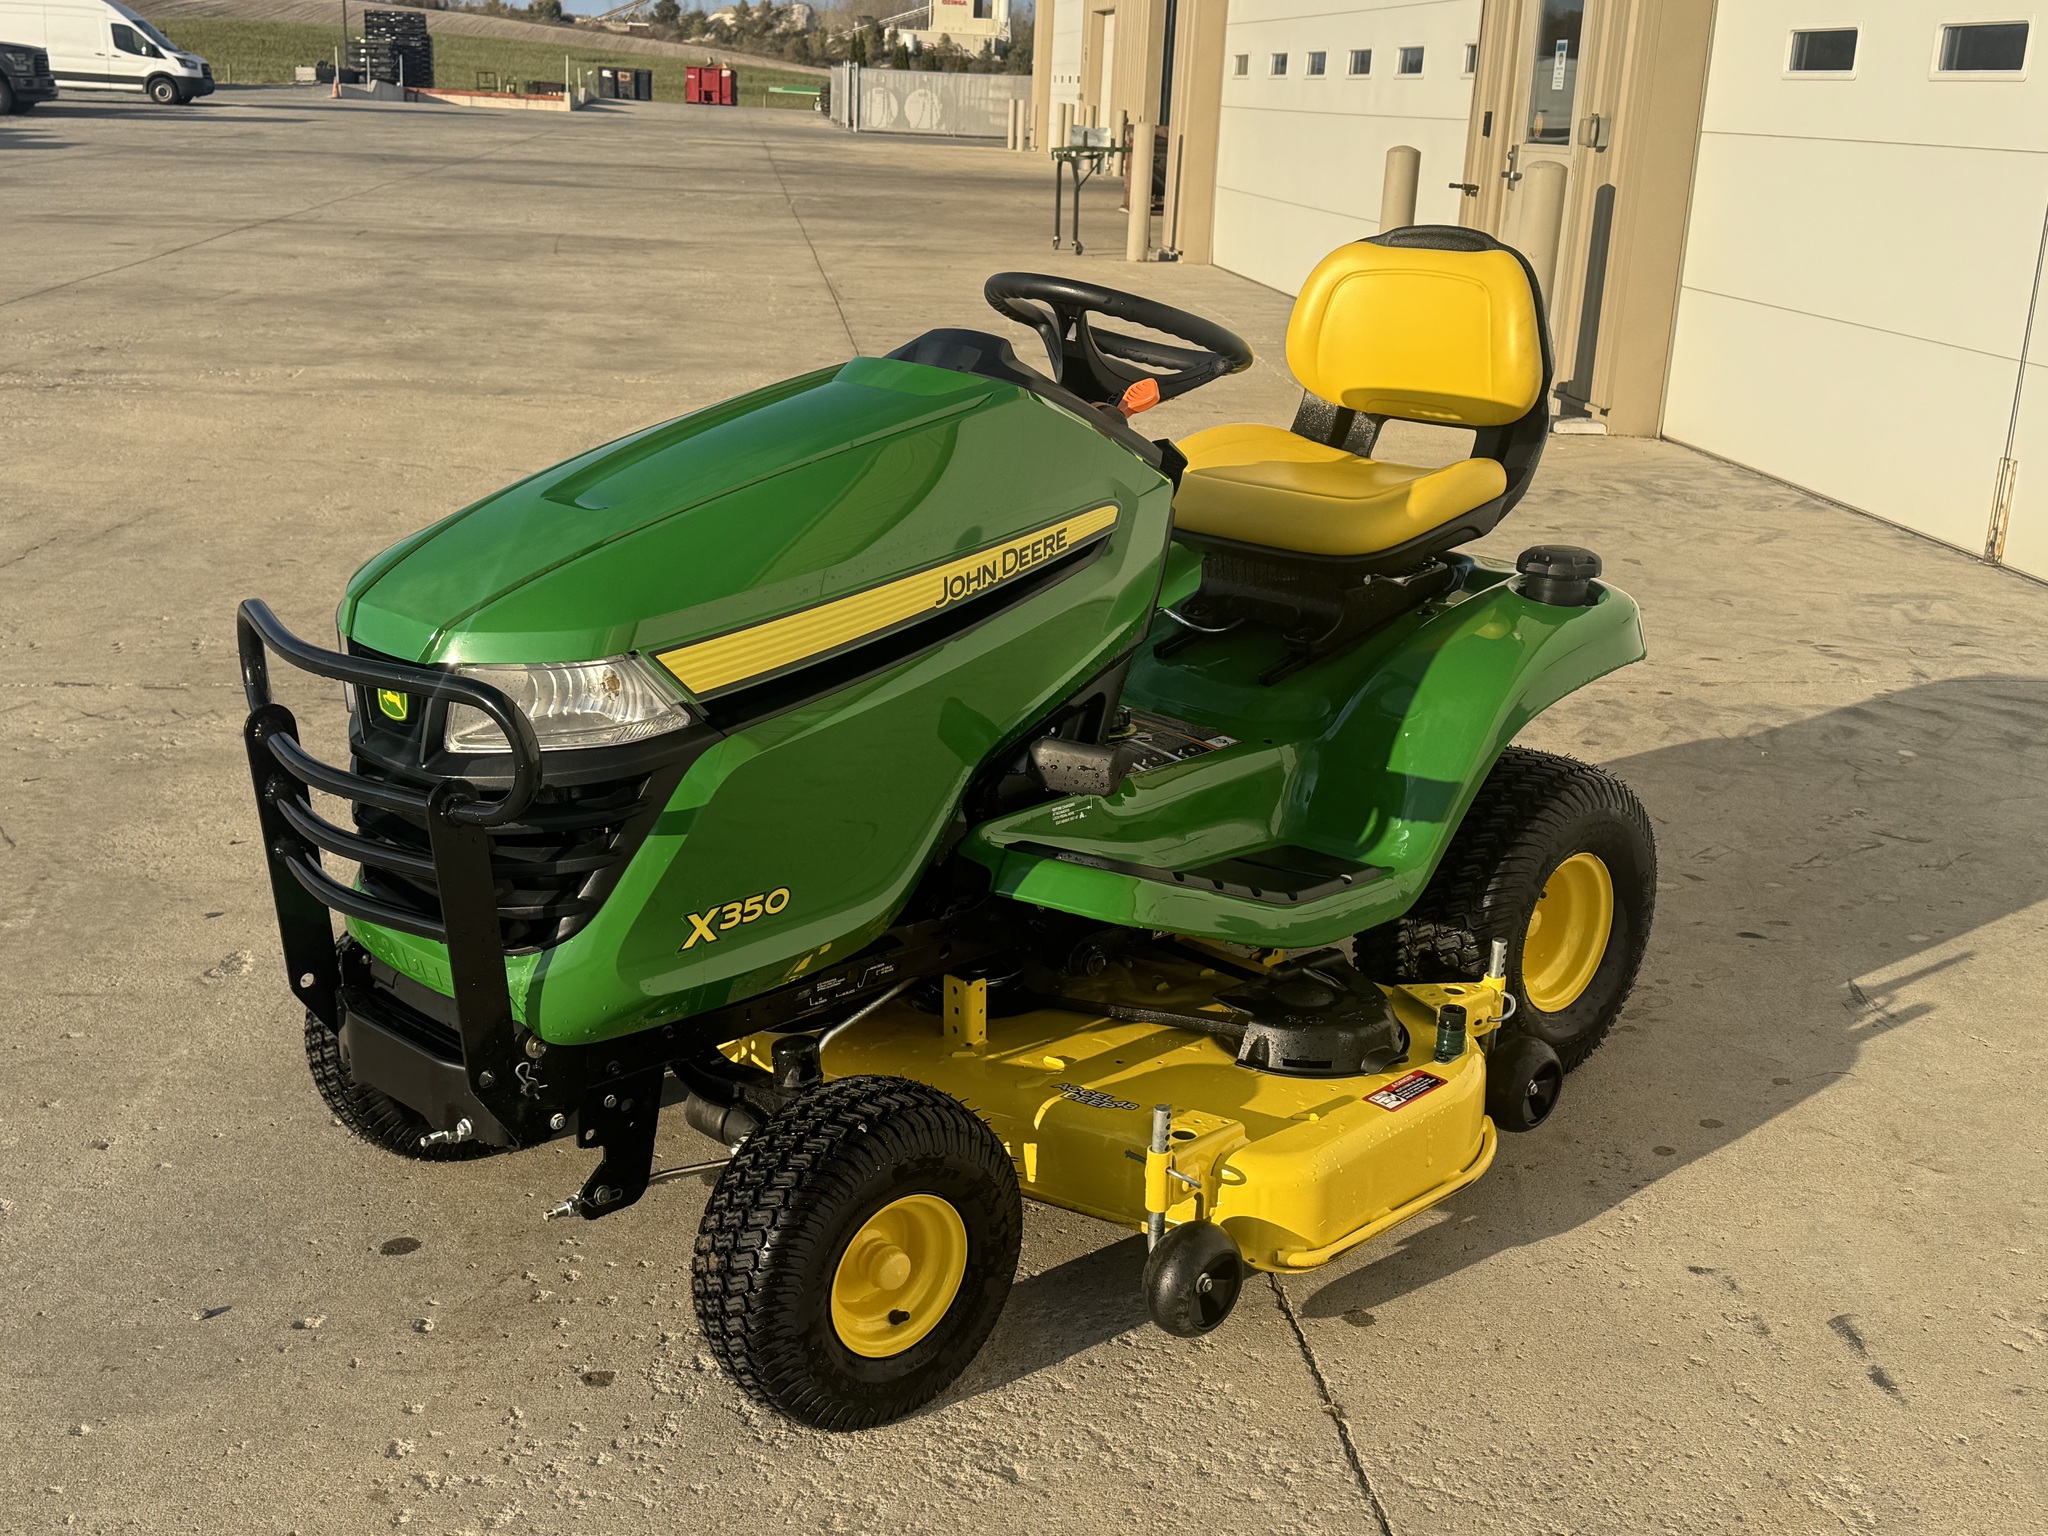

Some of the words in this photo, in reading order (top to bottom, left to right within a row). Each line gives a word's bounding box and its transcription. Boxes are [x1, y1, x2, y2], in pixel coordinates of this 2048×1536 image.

[935, 560, 997, 607] JOHN
[1002, 527, 1068, 576] DEERE
[679, 886, 791, 952] X350
[1051, 1083, 1115, 1103] ACCEL
[1112, 1101, 1140, 1110] 48
[1061, 1092, 1117, 1108] DEEP
